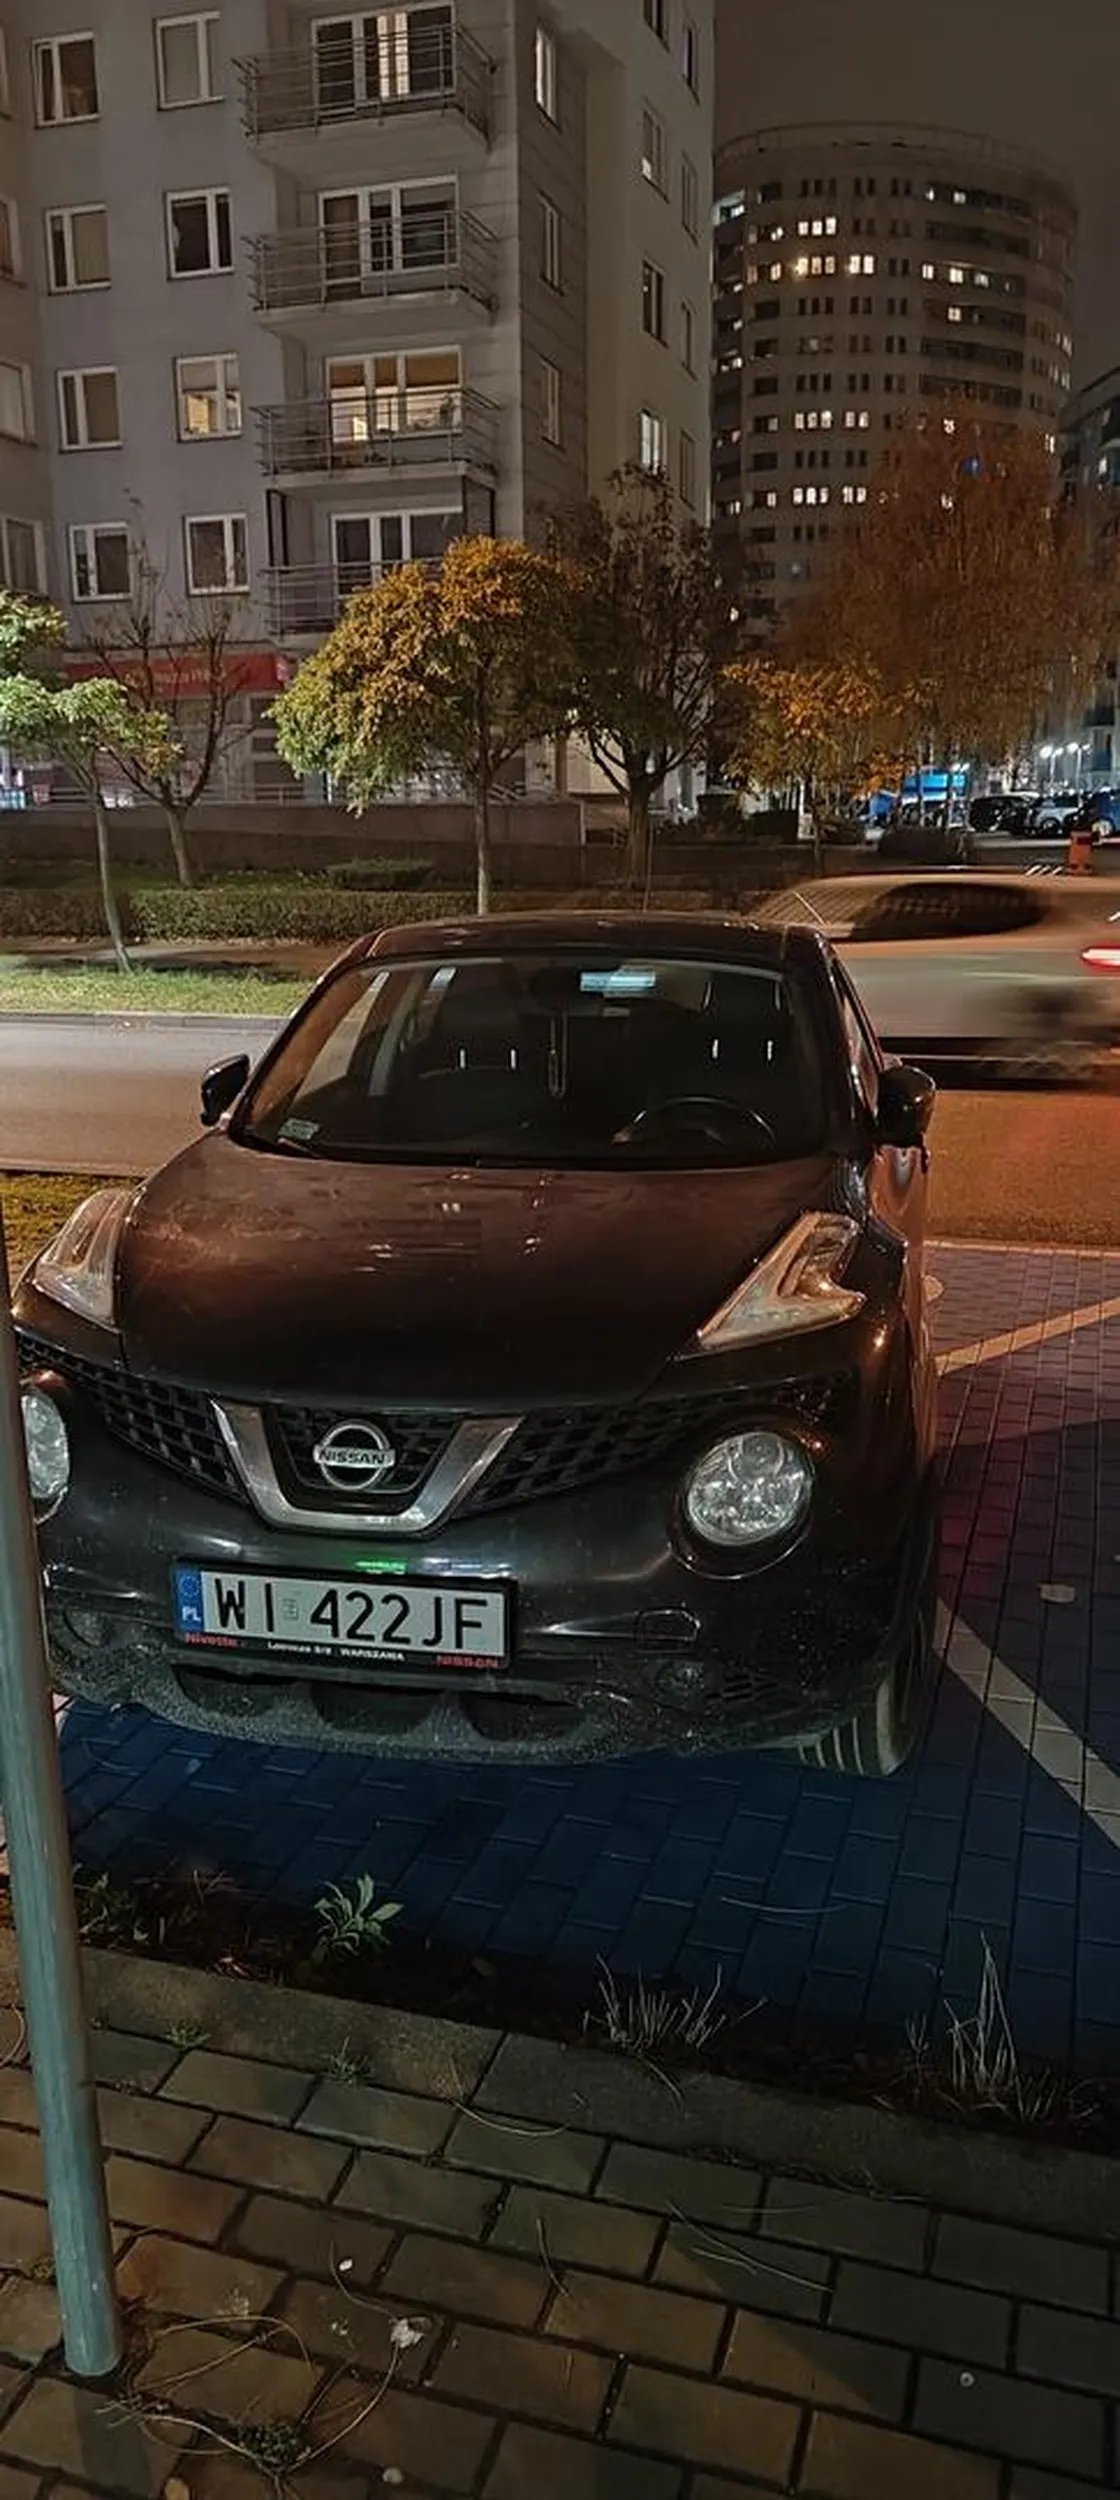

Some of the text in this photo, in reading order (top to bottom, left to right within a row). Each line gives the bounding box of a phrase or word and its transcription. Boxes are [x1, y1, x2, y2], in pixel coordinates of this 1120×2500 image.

[320, 1449, 386, 1466] NISSAN
[182, 1606, 201, 1620] PL
[214, 1577, 488, 1649] WI 422JF
[436, 1654, 499, 1669] NISSAN
